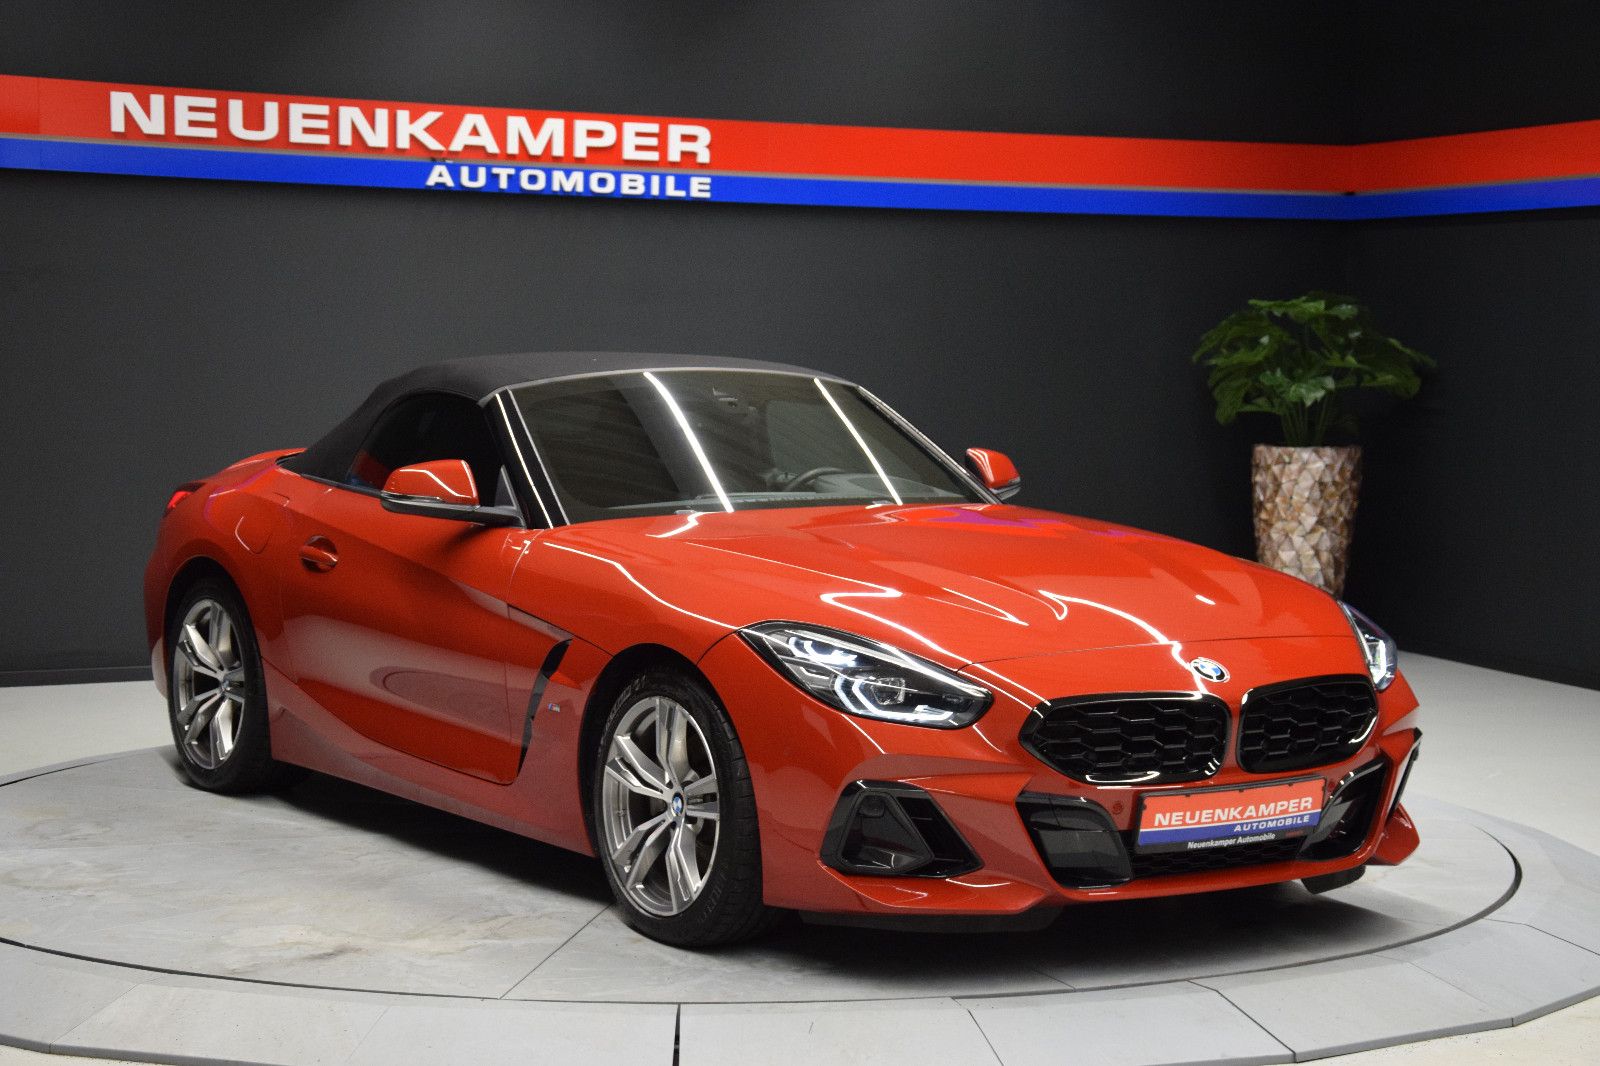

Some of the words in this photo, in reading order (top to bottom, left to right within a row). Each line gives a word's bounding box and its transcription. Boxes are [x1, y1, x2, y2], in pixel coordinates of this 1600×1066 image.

[109, 90, 712, 164] NEUENKAMPER
[425, 164, 712, 199] AUTOMOBILE
[1154, 797, 1313, 826] NEUENKAMPER
[1234, 815, 1310, 832] AUTOMOBILE
[1187, 838, 1236, 849] Neuenkamper
[1237, 832, 1276, 844] Automobile
